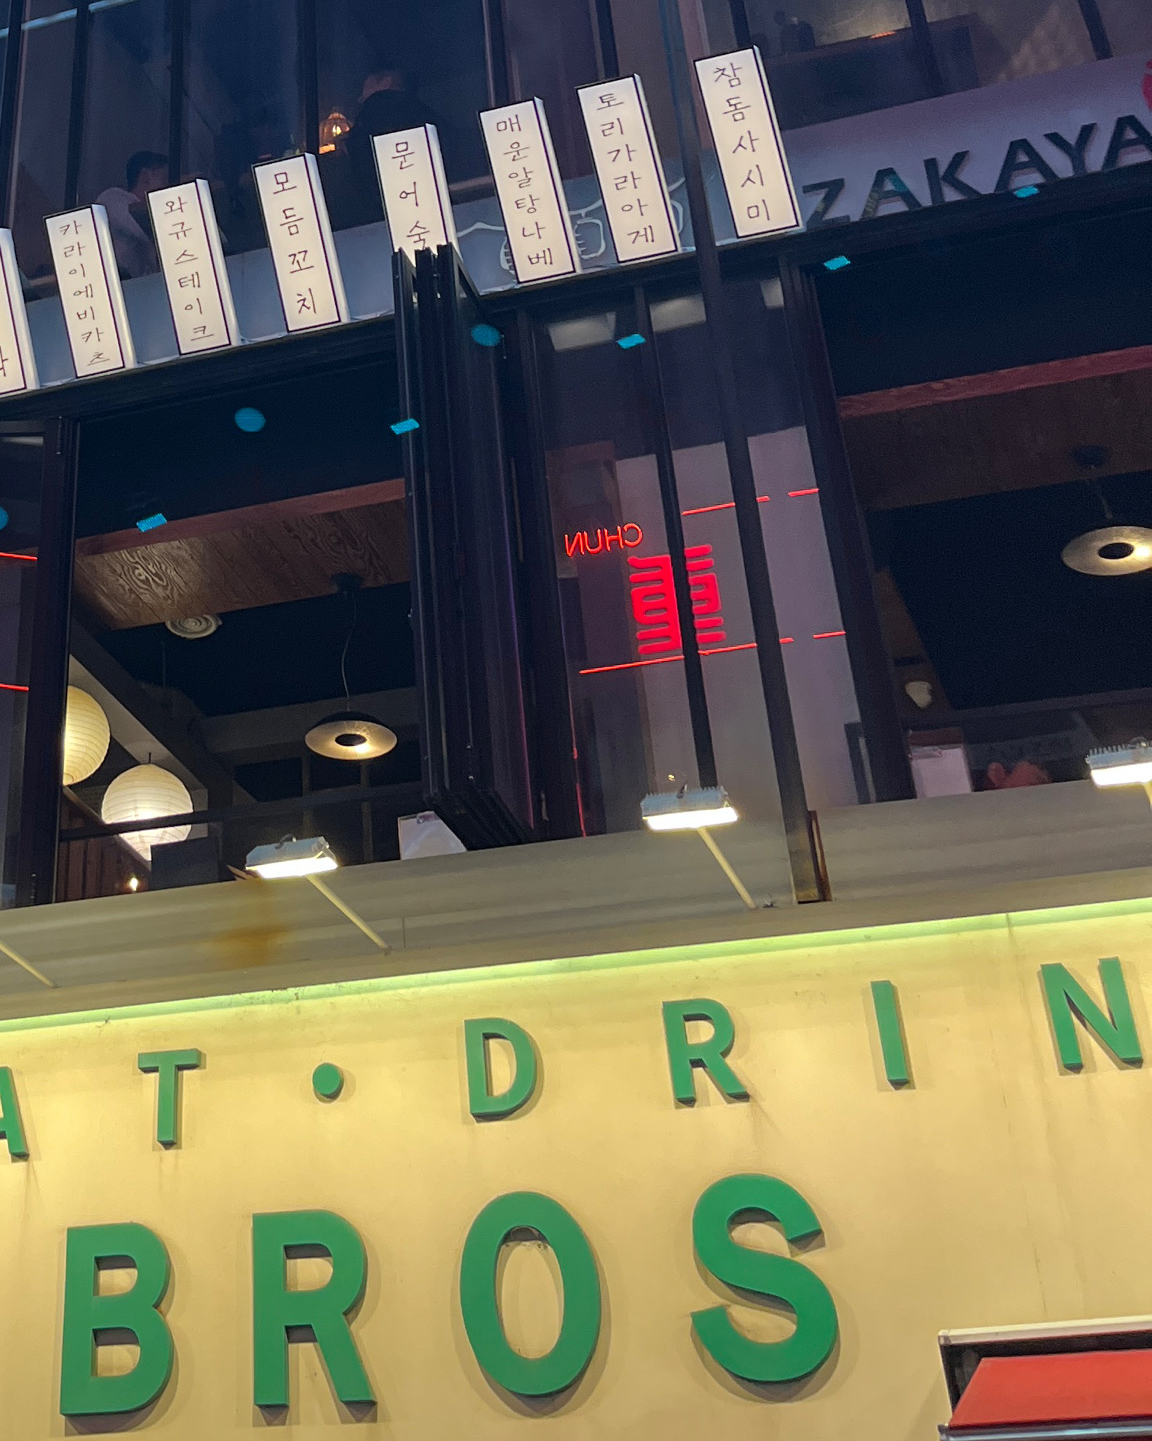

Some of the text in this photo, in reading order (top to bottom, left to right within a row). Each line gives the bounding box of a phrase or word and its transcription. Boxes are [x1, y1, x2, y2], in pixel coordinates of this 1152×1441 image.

[391, 140, 431, 249] 문어숙
[496, 114, 553, 266] 매운알탕나베
[597, 92, 655, 245] 토리가라아게
[713, 62, 771, 222] 참돔사시미
[59, 220, 110, 366] 카라이에비카츠
[163, 196, 215, 342] 와규스테이크
[272, 171, 317, 315] 모듬꼬치
[463, 957, 1143, 1120] DRIN
[59, 1172, 839, 1415] BROS
